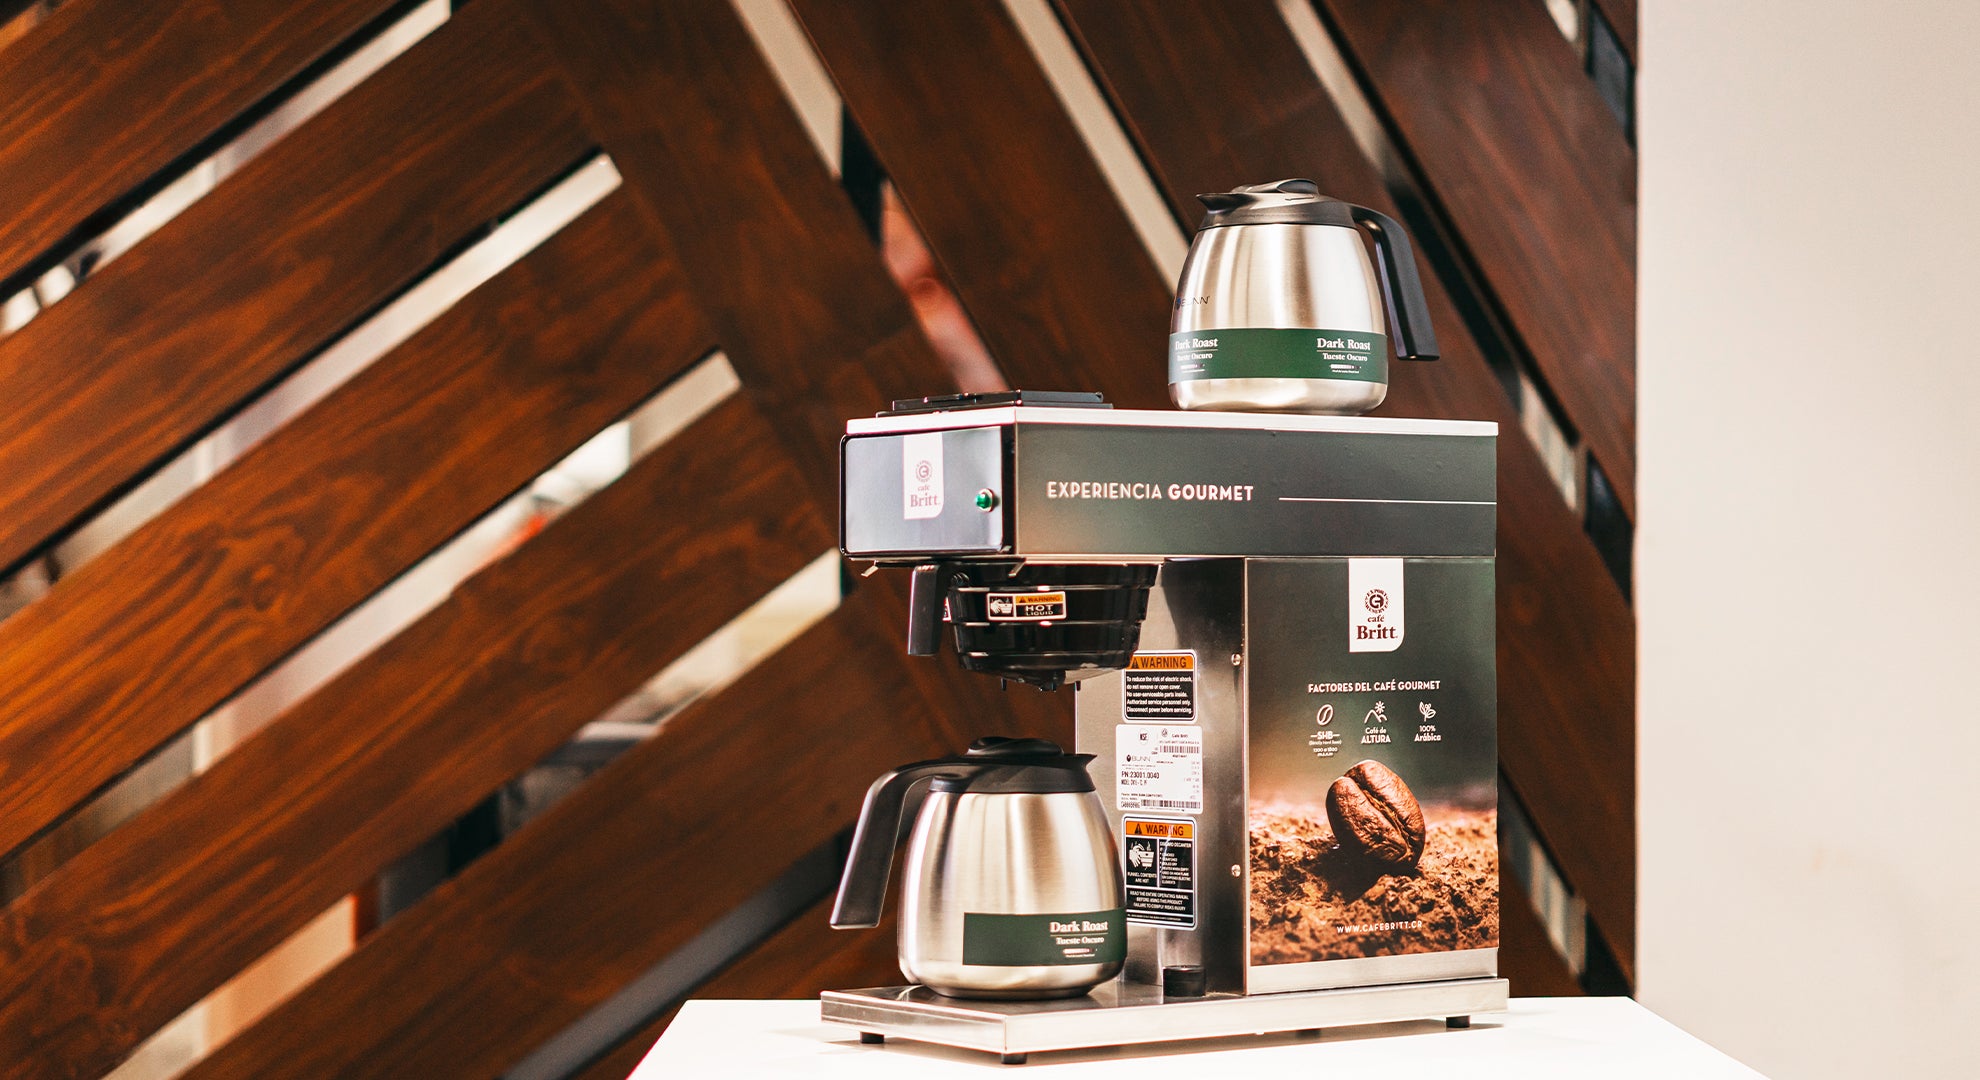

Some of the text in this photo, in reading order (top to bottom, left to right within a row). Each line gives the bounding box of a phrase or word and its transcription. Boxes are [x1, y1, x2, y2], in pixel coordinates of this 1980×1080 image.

[1192, 338, 1218, 348] Roast
[1316, 338, 1371, 350] Dark Roast
[1047, 481, 1254, 501] EXPERIENCIA GOURMET
[910, 492, 937, 507] Britt
[1028, 594, 1060, 602] WARNING
[1367, 614, 1385, 623] café
[1356, 624, 1396, 640] Britt
[1140, 656, 1187, 668] WARNING
[1308, 679, 1440, 693] FACTORES DEL CAFÉ GOURMET
[1318, 731, 1333, 740] SHB
[1361, 735, 1391, 744] ALTURA
[1414, 734, 1441, 742] Arábica
[1049, 921, 1109, 933] Dark Roast
[1336, 920, 1423, 933] WWW.CAFEBRITT.CR
[1055, 936, 1105, 945] Tueste Oscuro
